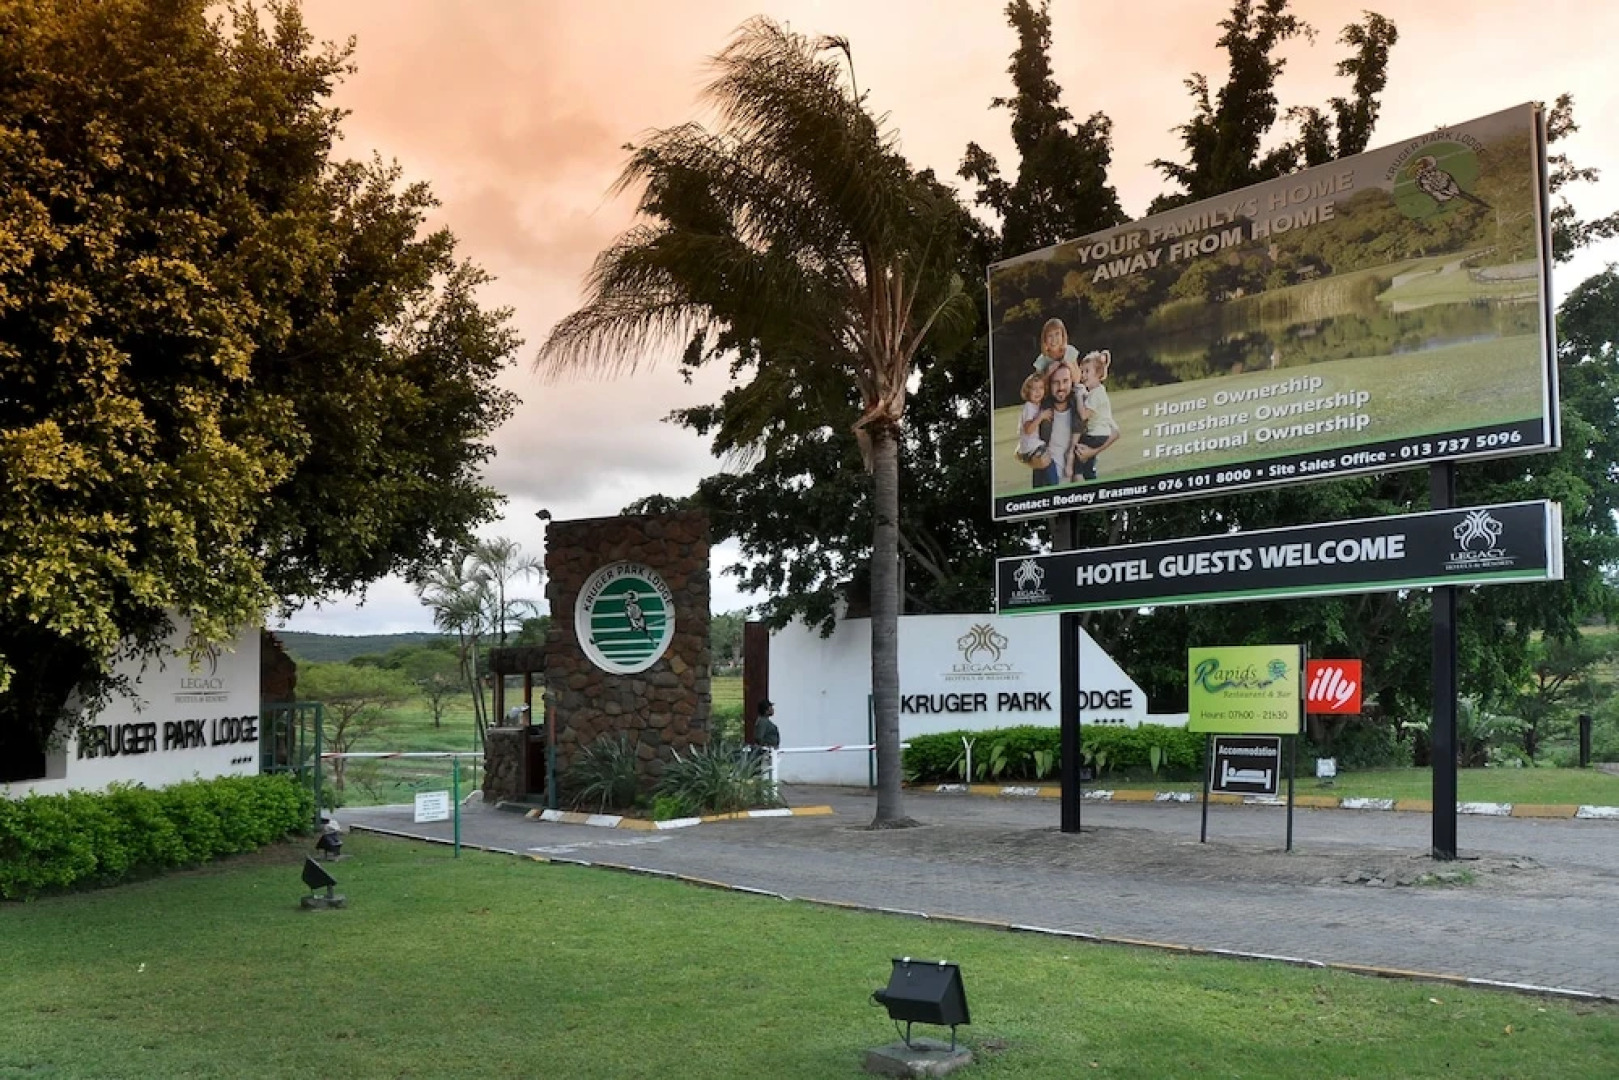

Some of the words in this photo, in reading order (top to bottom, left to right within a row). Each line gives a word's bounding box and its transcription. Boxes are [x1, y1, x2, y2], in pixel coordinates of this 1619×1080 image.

[1422, 131, 1453, 145] PARK
[1077, 231, 1143, 264] YOUR
[1269, 170, 1354, 213] HOME
[1092, 248, 1163, 284] AWAY
[1169, 226, 1243, 262] FROM
[1251, 200, 1336, 241] HOME
[1153, 397, 1208, 418] Home
[1213, 375, 1323, 407] Ownership
[1153, 411, 1249, 438] Timeshare
[1255, 389, 1371, 421] Ownership
[1154, 430, 1249, 459] Fractional
[1255, 412, 1371, 444] Ownership
[1005, 498, 1050, 513] Contact:
[1053, 492, 1095, 507] Rodney
[1098, 484, 1148, 499] Erasmus
[1158, 478, 1183, 491] 076
[1187, 473, 1211, 487] 101
[1216, 468, 1251, 484] 8000
[1268, 464, 1296, 477] Site
[1299, 458, 1336, 473] Sales
[1340, 450, 1387, 466] Office
[1400, 443, 1432, 458] 013
[1437, 438, 1470, 453] 737
[1476, 431, 1522, 448] 5096
[1076, 559, 1154, 587] HOTEL
[1158, 547, 1254, 579] GUESTS
[1258, 534, 1406, 569] WELCOME
[1450, 548, 1506, 560] LEGACY
[582, 570, 615, 612] KRUGER
[616, 564, 646, 576] PARK
[647, 572, 673, 608] LODGE
[180, 677, 226, 689] LEGACY
[952, 663, 1014, 673] LEGACY
[1195, 658, 1258, 693] Rapids
[1308, 666, 1357, 710] illy
[901, 693, 987, 714] KRUGER
[997, 691, 1052, 712] PARK
[1078, 689, 1133, 710] ODGE
[163, 718, 207, 750] PARK
[211, 715, 259, 746] LODGE
[1218, 744, 1278, 757] Accommodation
